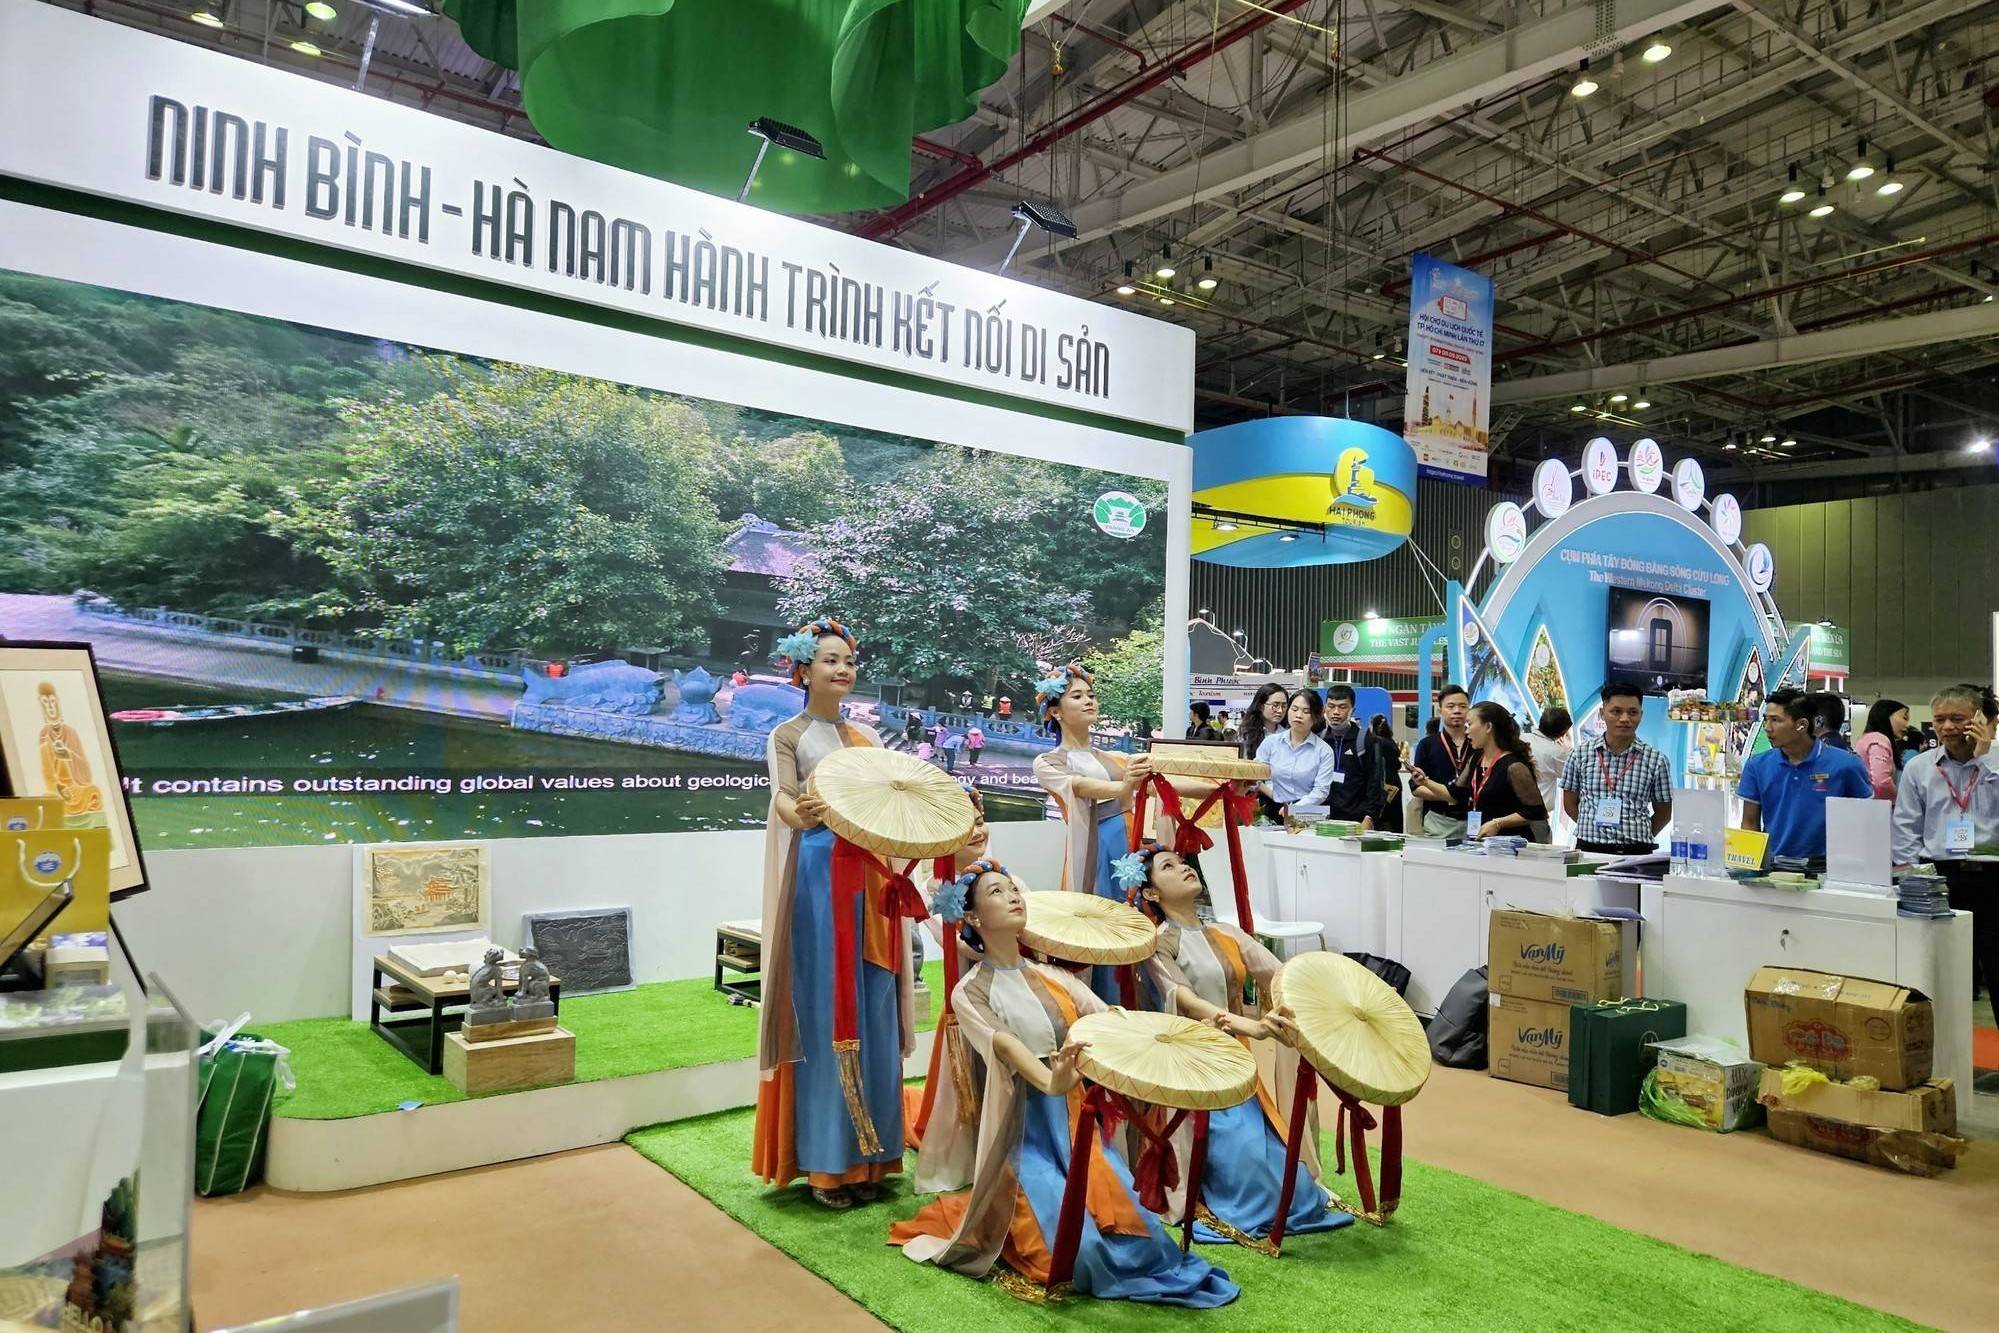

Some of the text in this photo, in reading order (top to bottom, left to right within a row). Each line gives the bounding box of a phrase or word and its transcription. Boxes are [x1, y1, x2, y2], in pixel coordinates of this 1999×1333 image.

[145, 94, 289, 210] NINH
[305, 130, 432, 244] BÌNH
[471, 177, 535, 269] HÀ
[548, 199, 652, 296] NAM
[663, 227, 769, 322] HÀNH
[781, 260, 884, 348] TRÌNH
[892, 280, 956, 363] KẾT
[964, 298, 1013, 377] NỐI
[1020, 324, 1047, 384] DI
[1056, 323, 1111, 399] SẢN
[1347, 508, 1376, 520] PHONG
[1560, 549, 1581, 566] CỤM
[1581, 551, 1602, 567] PHÍA
[1710, 570, 1730, 586] LONG
[1589, 570, 1604, 583] The
[1605, 572, 1635, 586] Western
[1371, 638, 1387, 648] THE
[1388, 637, 1410, 648] VAST
[151, 776, 284, 794] contains
[292, 775, 452, 794] outstanding
[459, 775, 534, 794] global
[541, 774, 615, 790] values
[621, 774, 681, 789] about
[980, 773, 1008, 785] and
[1727, 853, 1756, 865] TRAVEL
